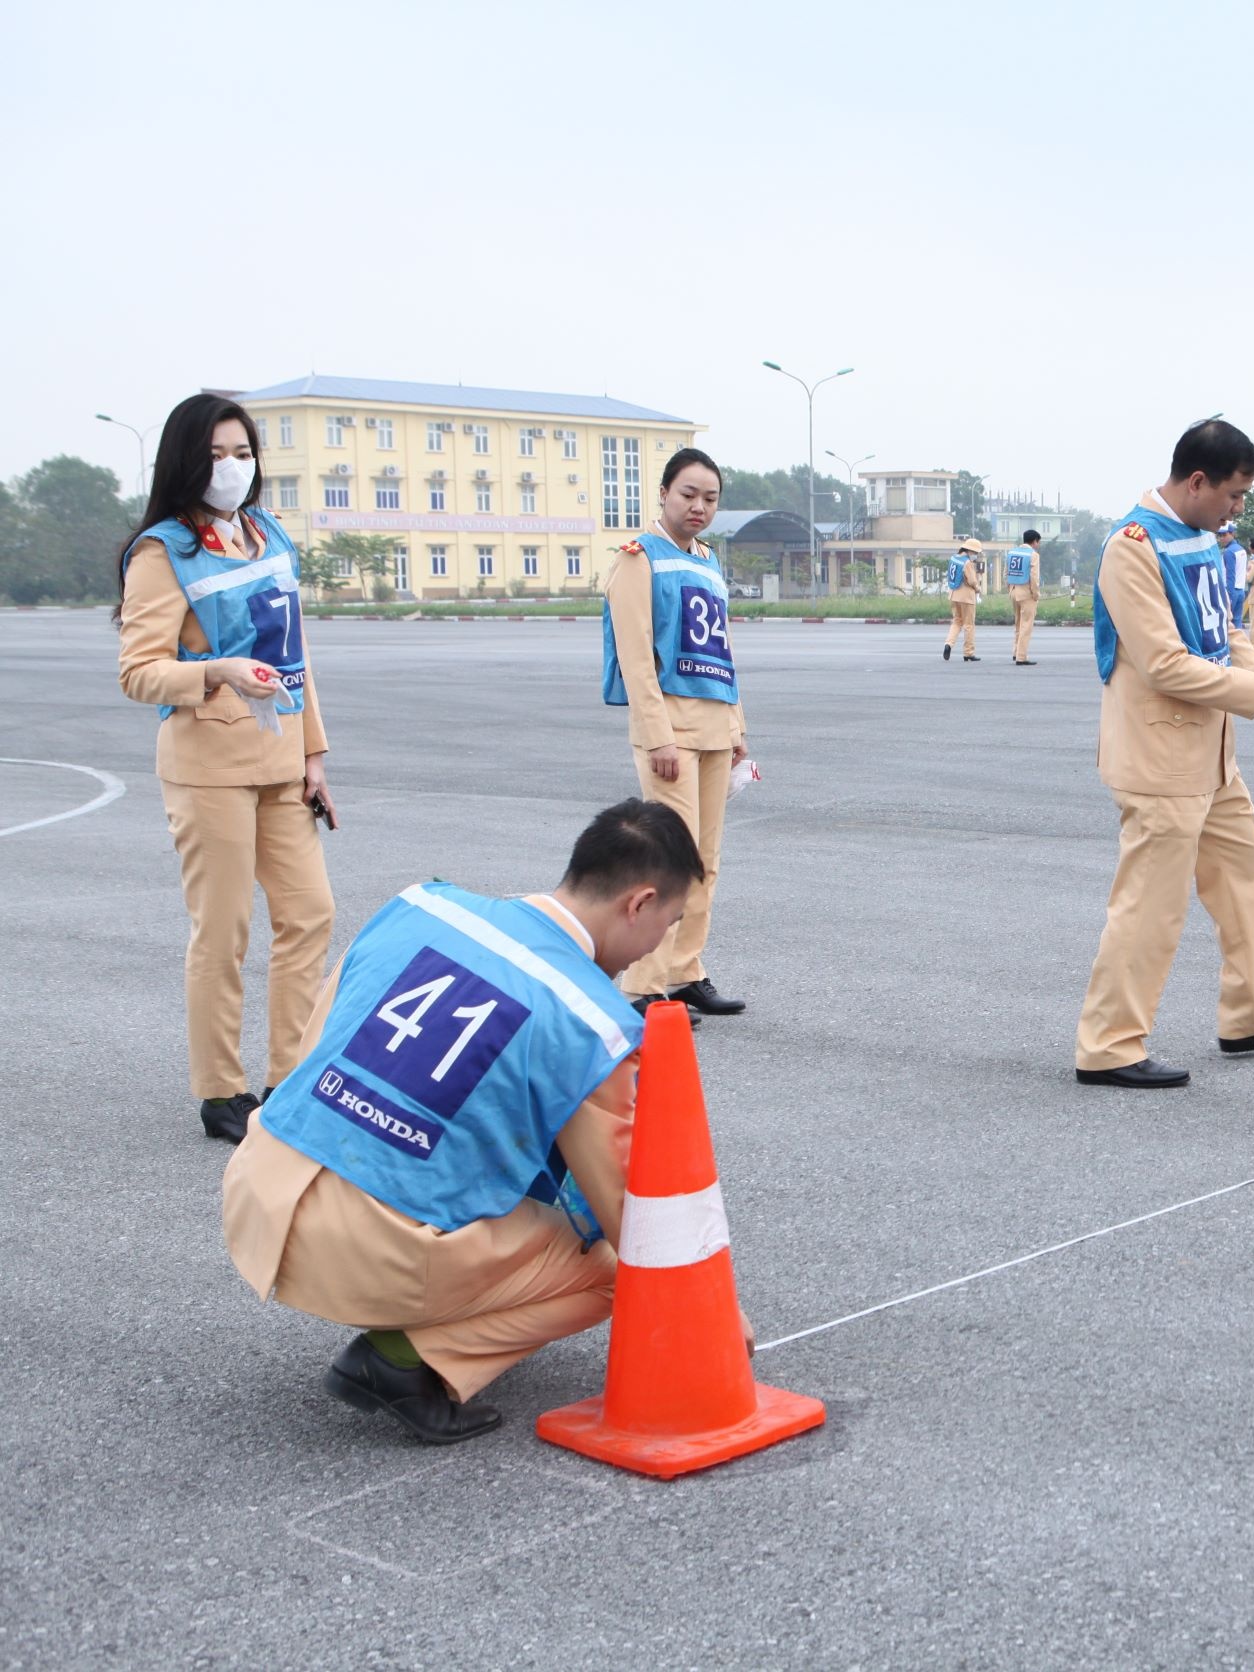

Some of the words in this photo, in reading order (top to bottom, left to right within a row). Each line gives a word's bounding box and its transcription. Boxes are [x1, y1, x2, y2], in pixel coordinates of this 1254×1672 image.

[1010, 556, 1022, 570] 51
[269, 594, 291, 657] 7
[689, 595, 728, 650] 34
[694, 664, 732, 679] HONDA
[376, 974, 498, 1082] 41
[337, 1089, 431, 1150] HONDA
